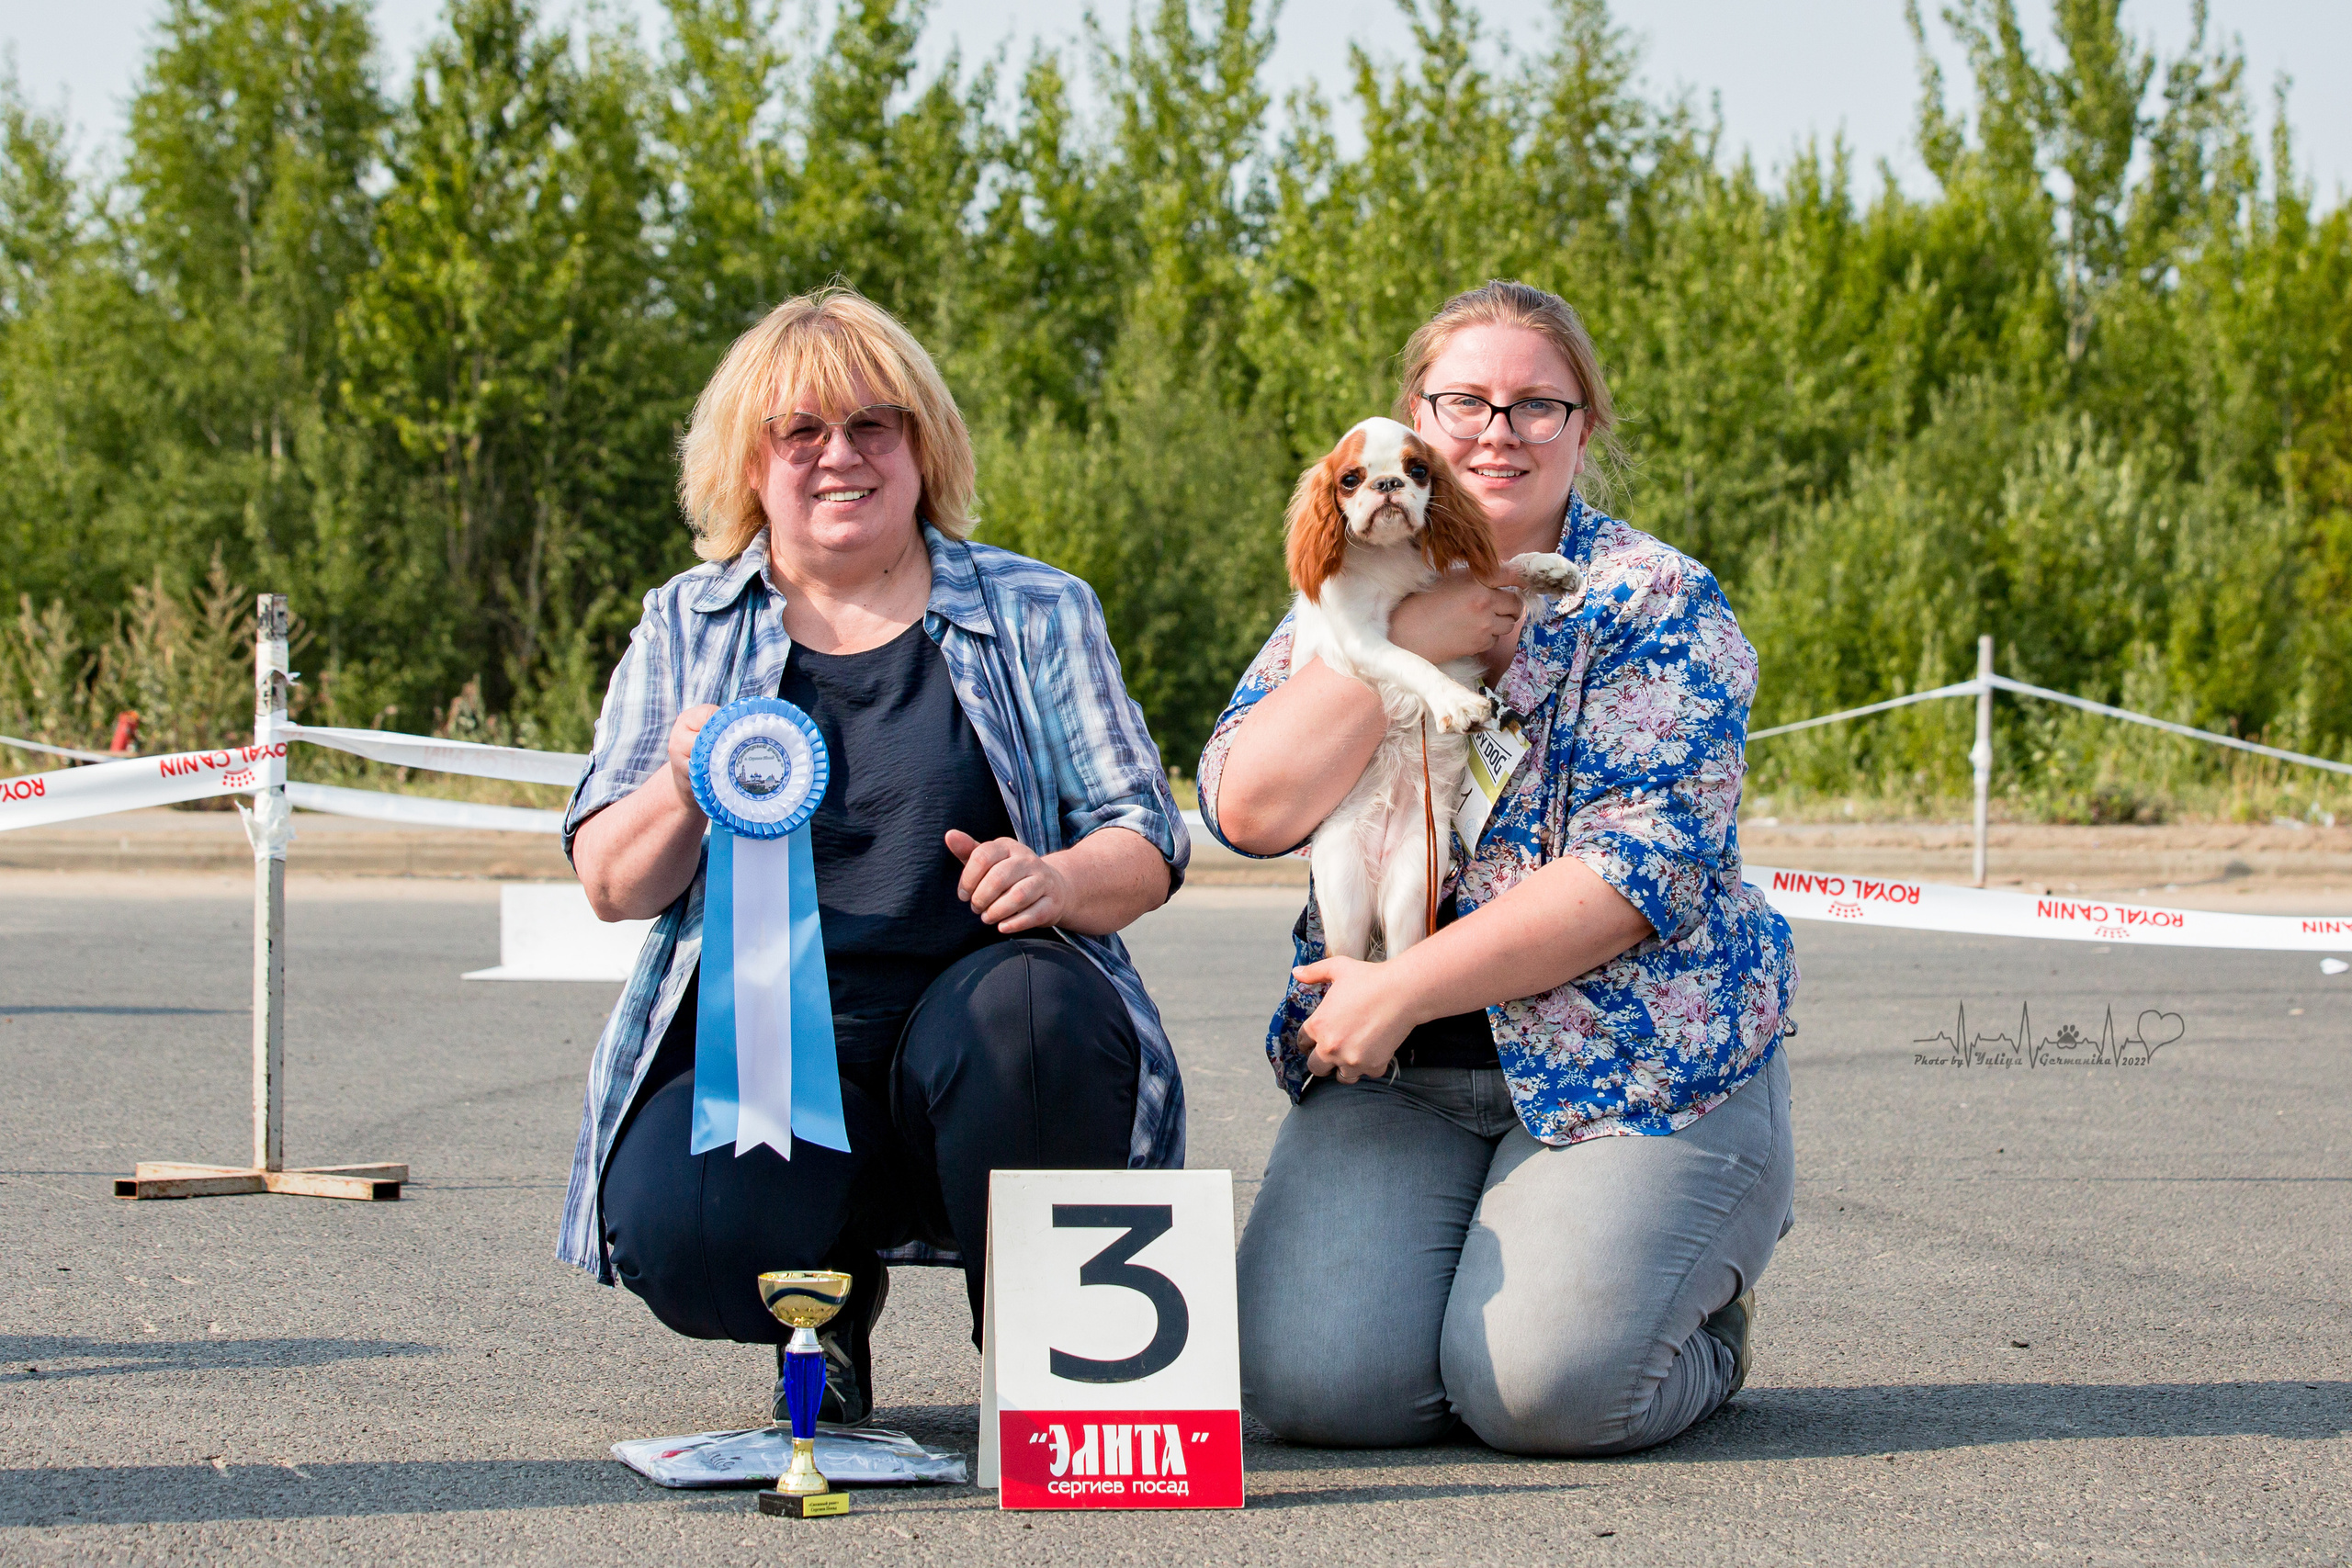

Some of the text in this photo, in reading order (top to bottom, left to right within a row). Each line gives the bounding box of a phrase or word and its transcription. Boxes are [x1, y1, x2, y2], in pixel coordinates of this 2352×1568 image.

[160, 742, 288, 778] OYAL CANIN
[1484, 740, 1508, 776] DOG
[0, 777, 46, 803] ROY
[1773, 871, 1920, 905] ROYAL CANIN
[2038, 900, 2184, 928] ROYAL CANIN
[2301, 920, 2352, 933] ANIN
[1049, 1203, 1189, 1384] 3
[1047, 1479, 1189, 1499] сергиев посад
